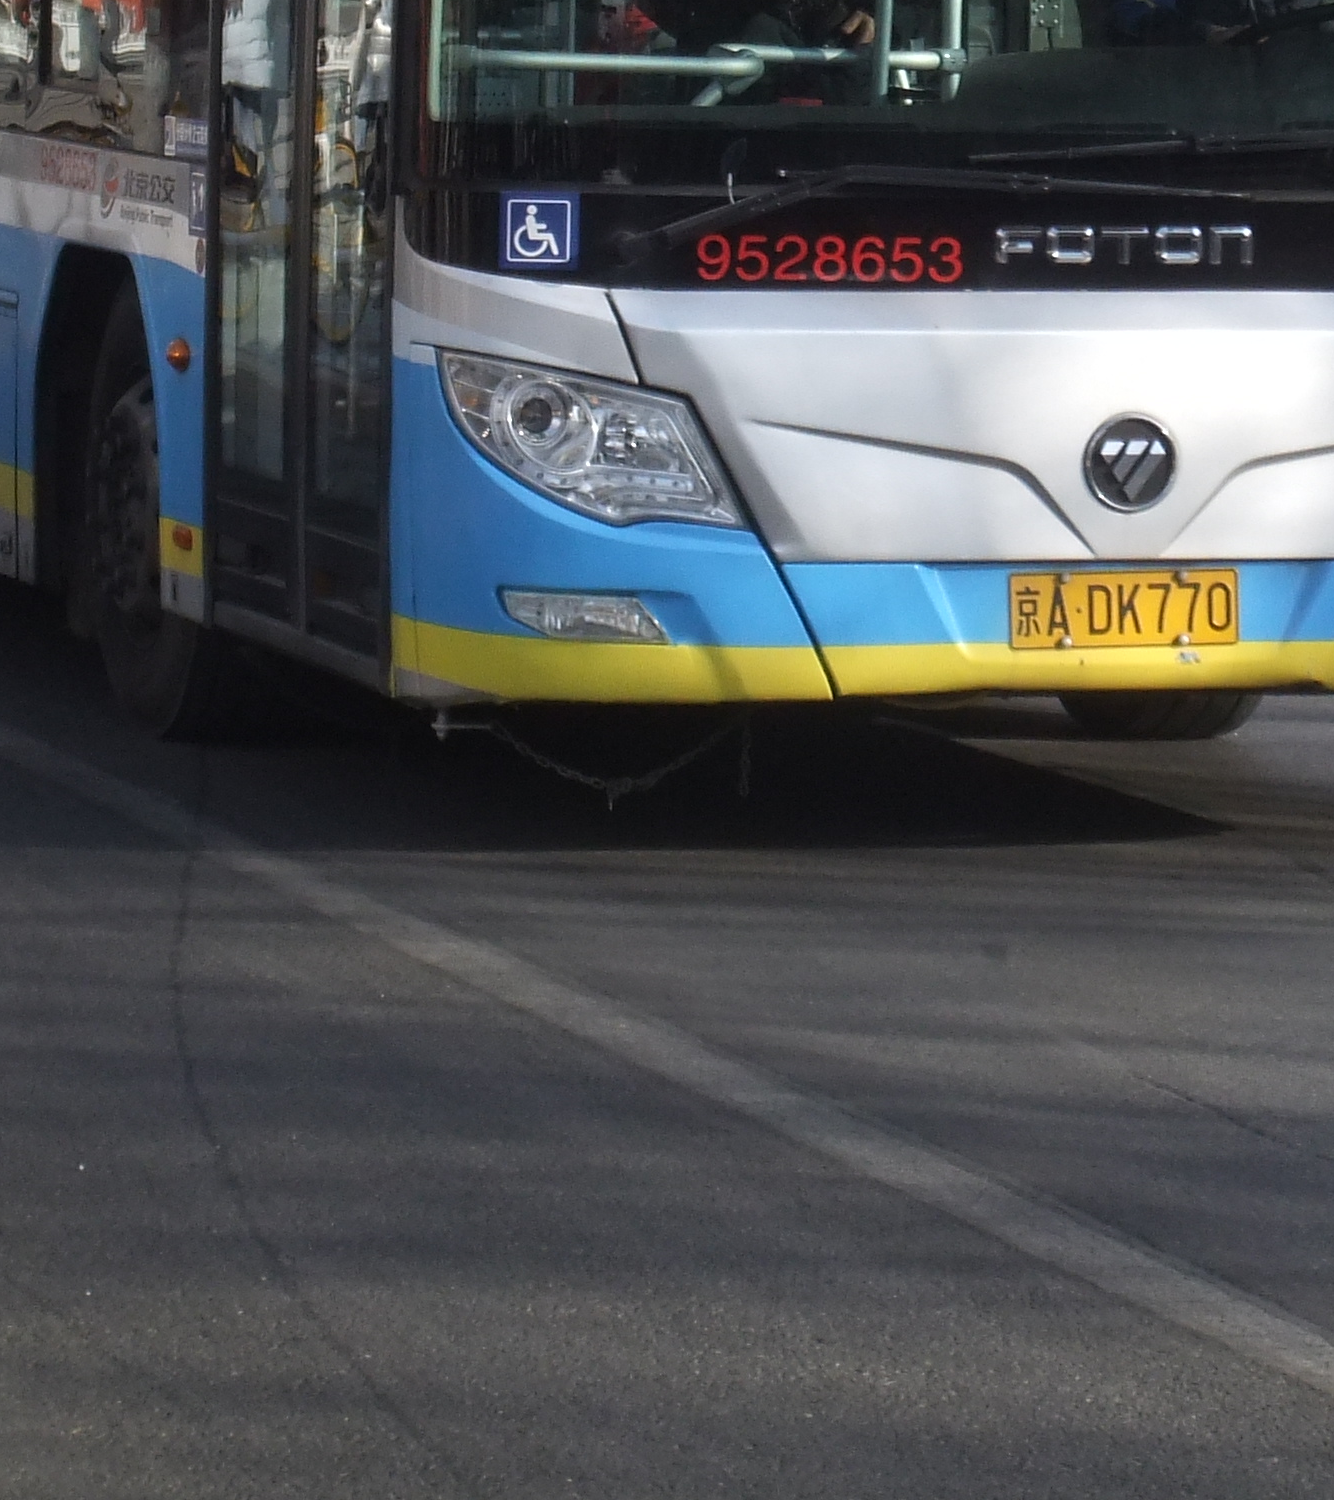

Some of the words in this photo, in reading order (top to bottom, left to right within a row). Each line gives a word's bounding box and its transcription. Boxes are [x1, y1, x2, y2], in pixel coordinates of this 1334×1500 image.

[123, 167, 175, 205] 北京公交
[696, 234, 964, 283] 9528653
[995, 225, 1254, 265] FOTON
